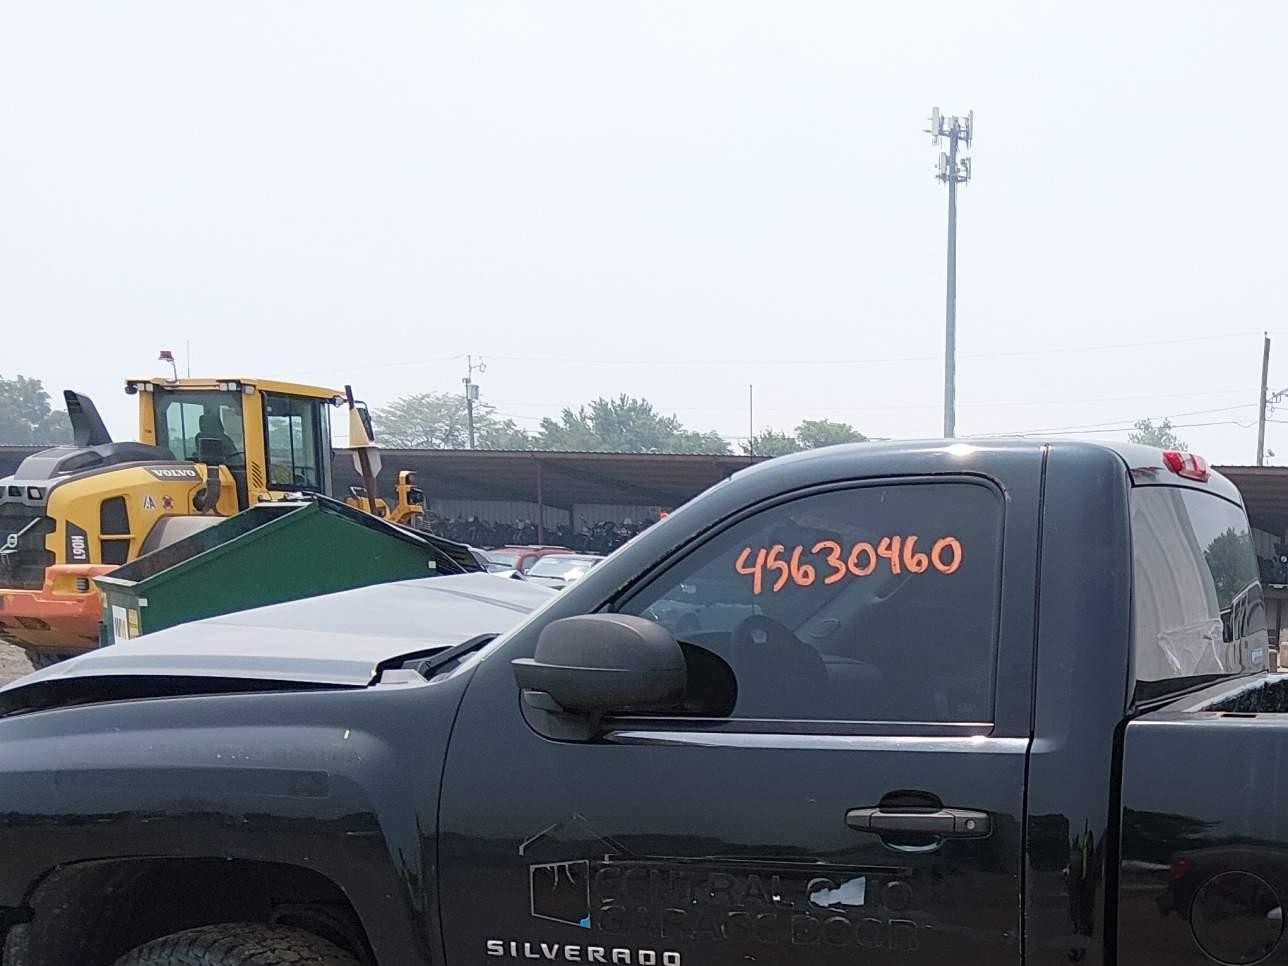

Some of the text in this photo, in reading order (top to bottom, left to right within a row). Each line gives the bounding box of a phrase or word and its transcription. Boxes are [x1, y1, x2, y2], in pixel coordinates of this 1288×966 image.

[151, 469, 197, 477] VOLVO
[71, 535, 86, 560] L90H
[736, 536, 963, 594] 45630460
[791, 914, 920, 951] DOOR
